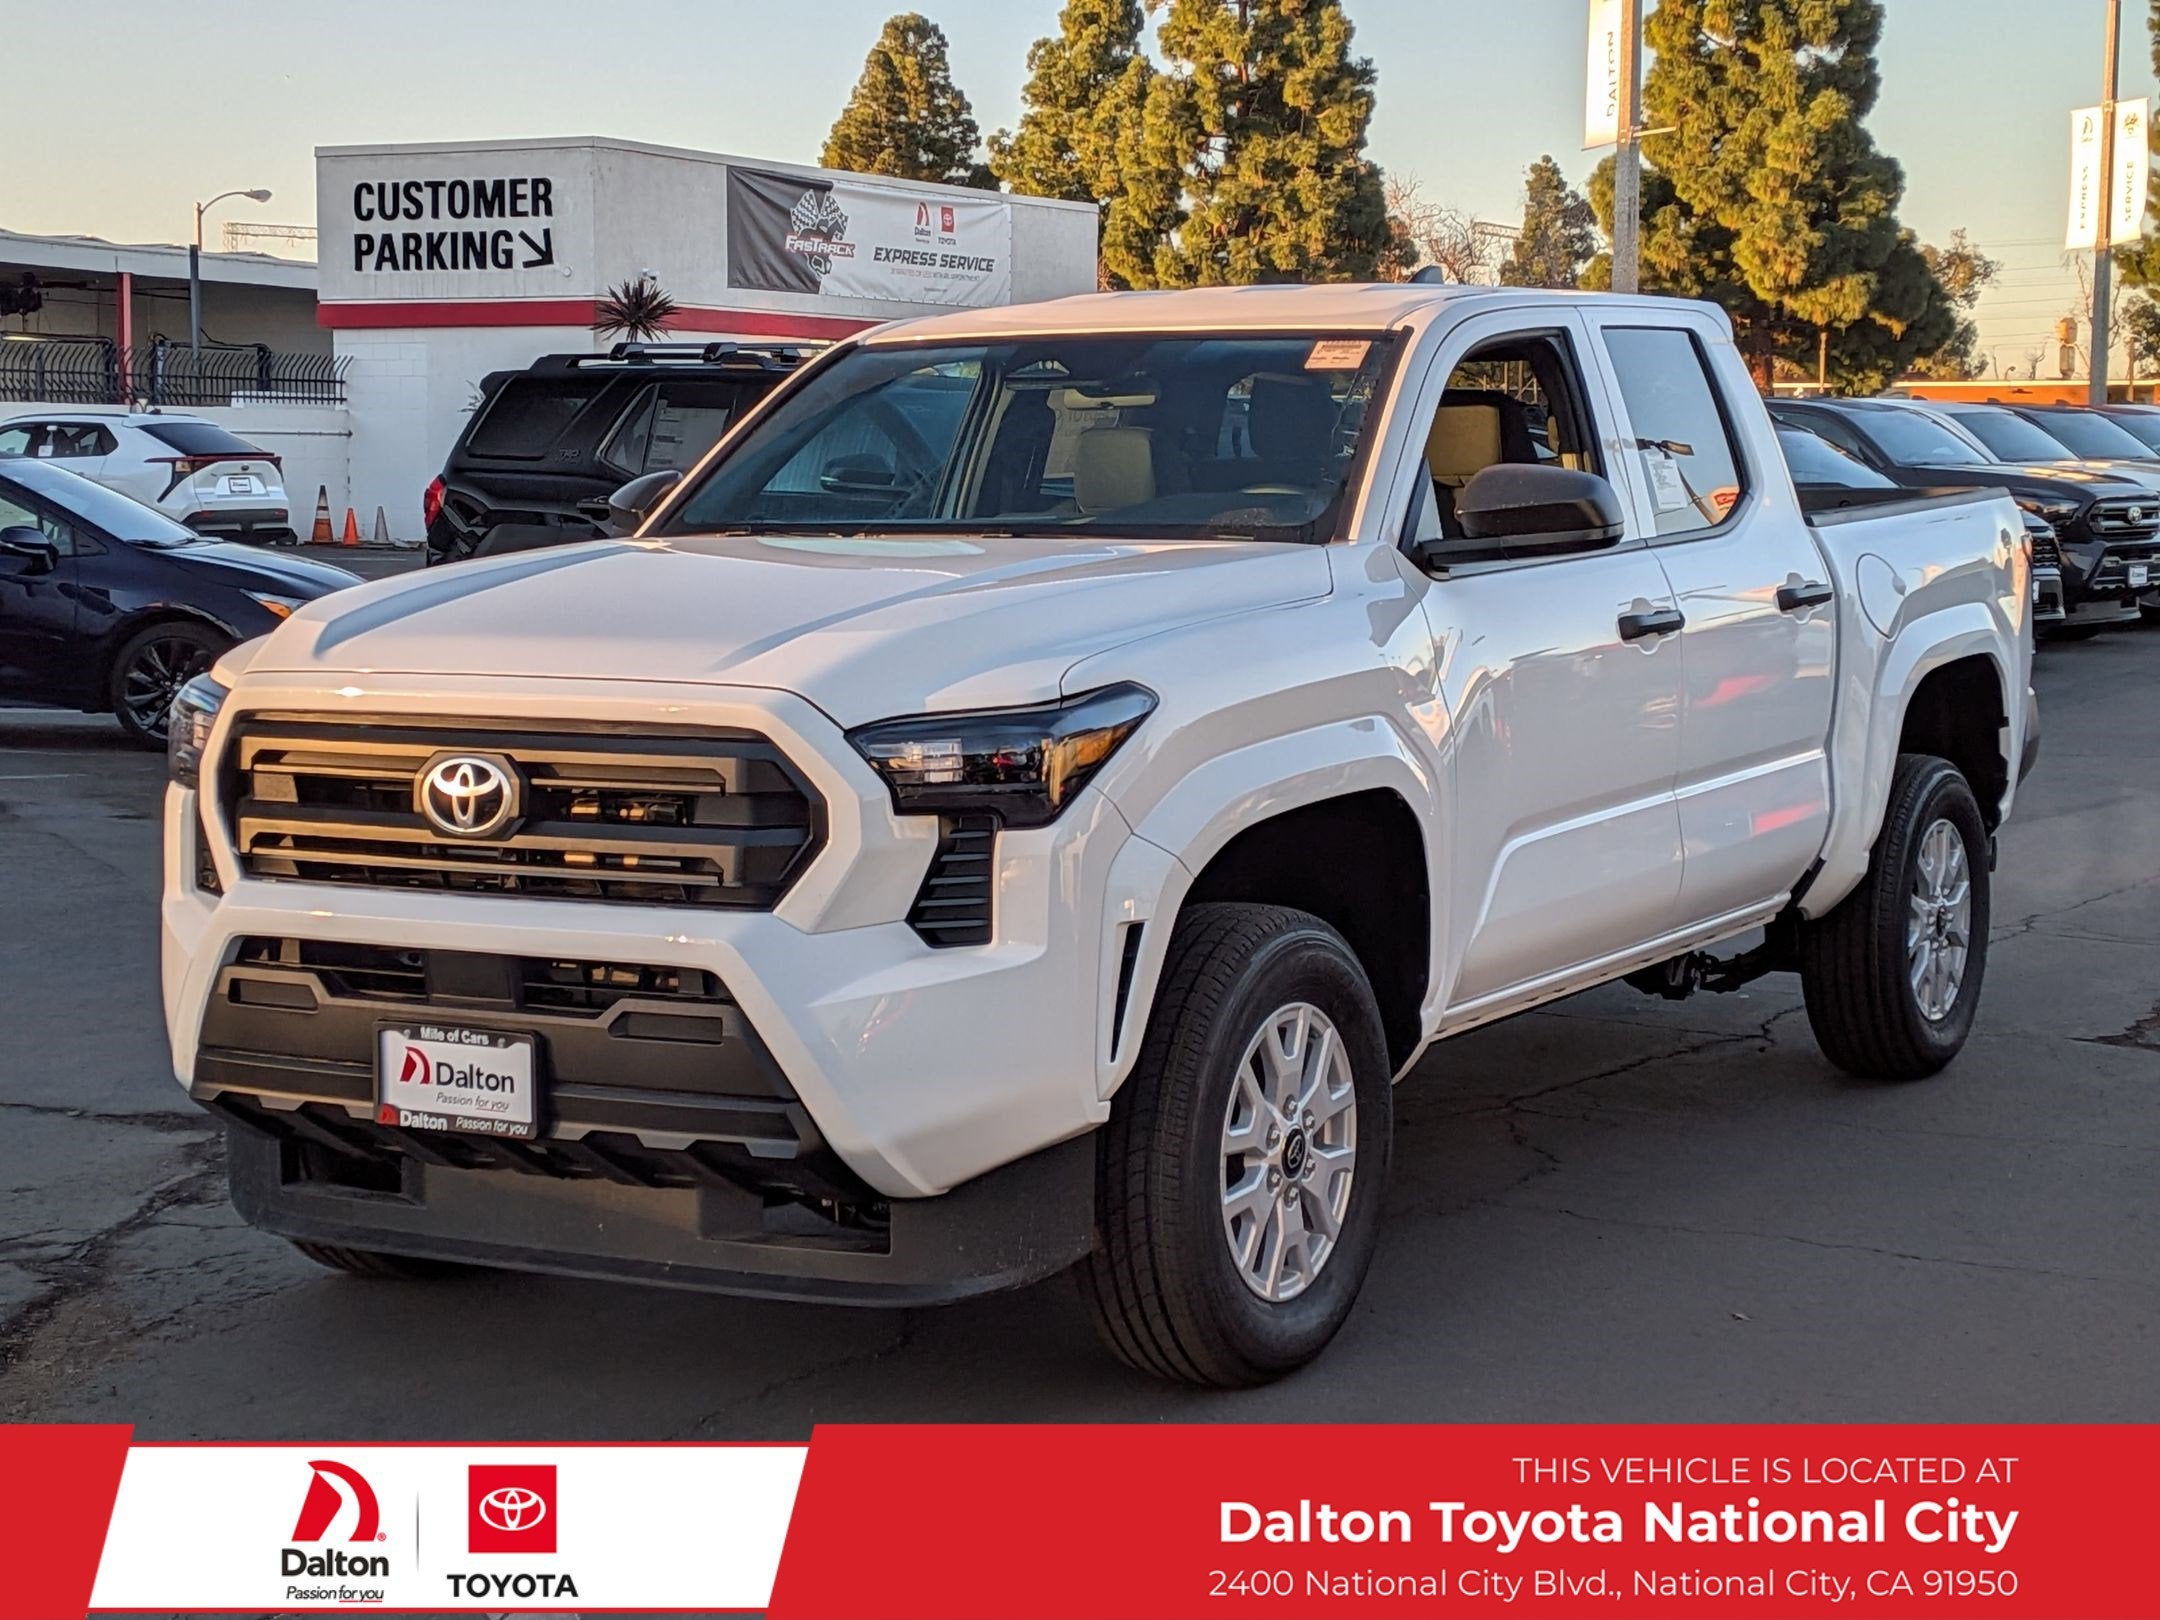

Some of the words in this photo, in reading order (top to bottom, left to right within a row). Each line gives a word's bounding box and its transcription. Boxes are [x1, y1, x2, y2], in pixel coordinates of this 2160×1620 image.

[354, 177, 553, 221] CUSTOMER
[2124, 160, 2135, 222] SERVICE
[354, 229, 514, 272] PARKING
[873, 246, 938, 267] EXPRESS
[938, 253, 996, 273] SERVICE
[420, 1026, 445, 1042] Mile
[447, 1029, 460, 1042] of
[461, 1031, 490, 1046] Cars
[436, 1061, 515, 1094] Dalton
[435, 1092, 473, 1106] Passion
[474, 1095, 491, 1109] for
[490, 1099, 510, 1111] you
[400, 1110, 448, 1131] Dalton
[455, 1116, 493, 1132] Passion
[493, 1119, 509, 1134] for
[509, 1123, 529, 1136] you
